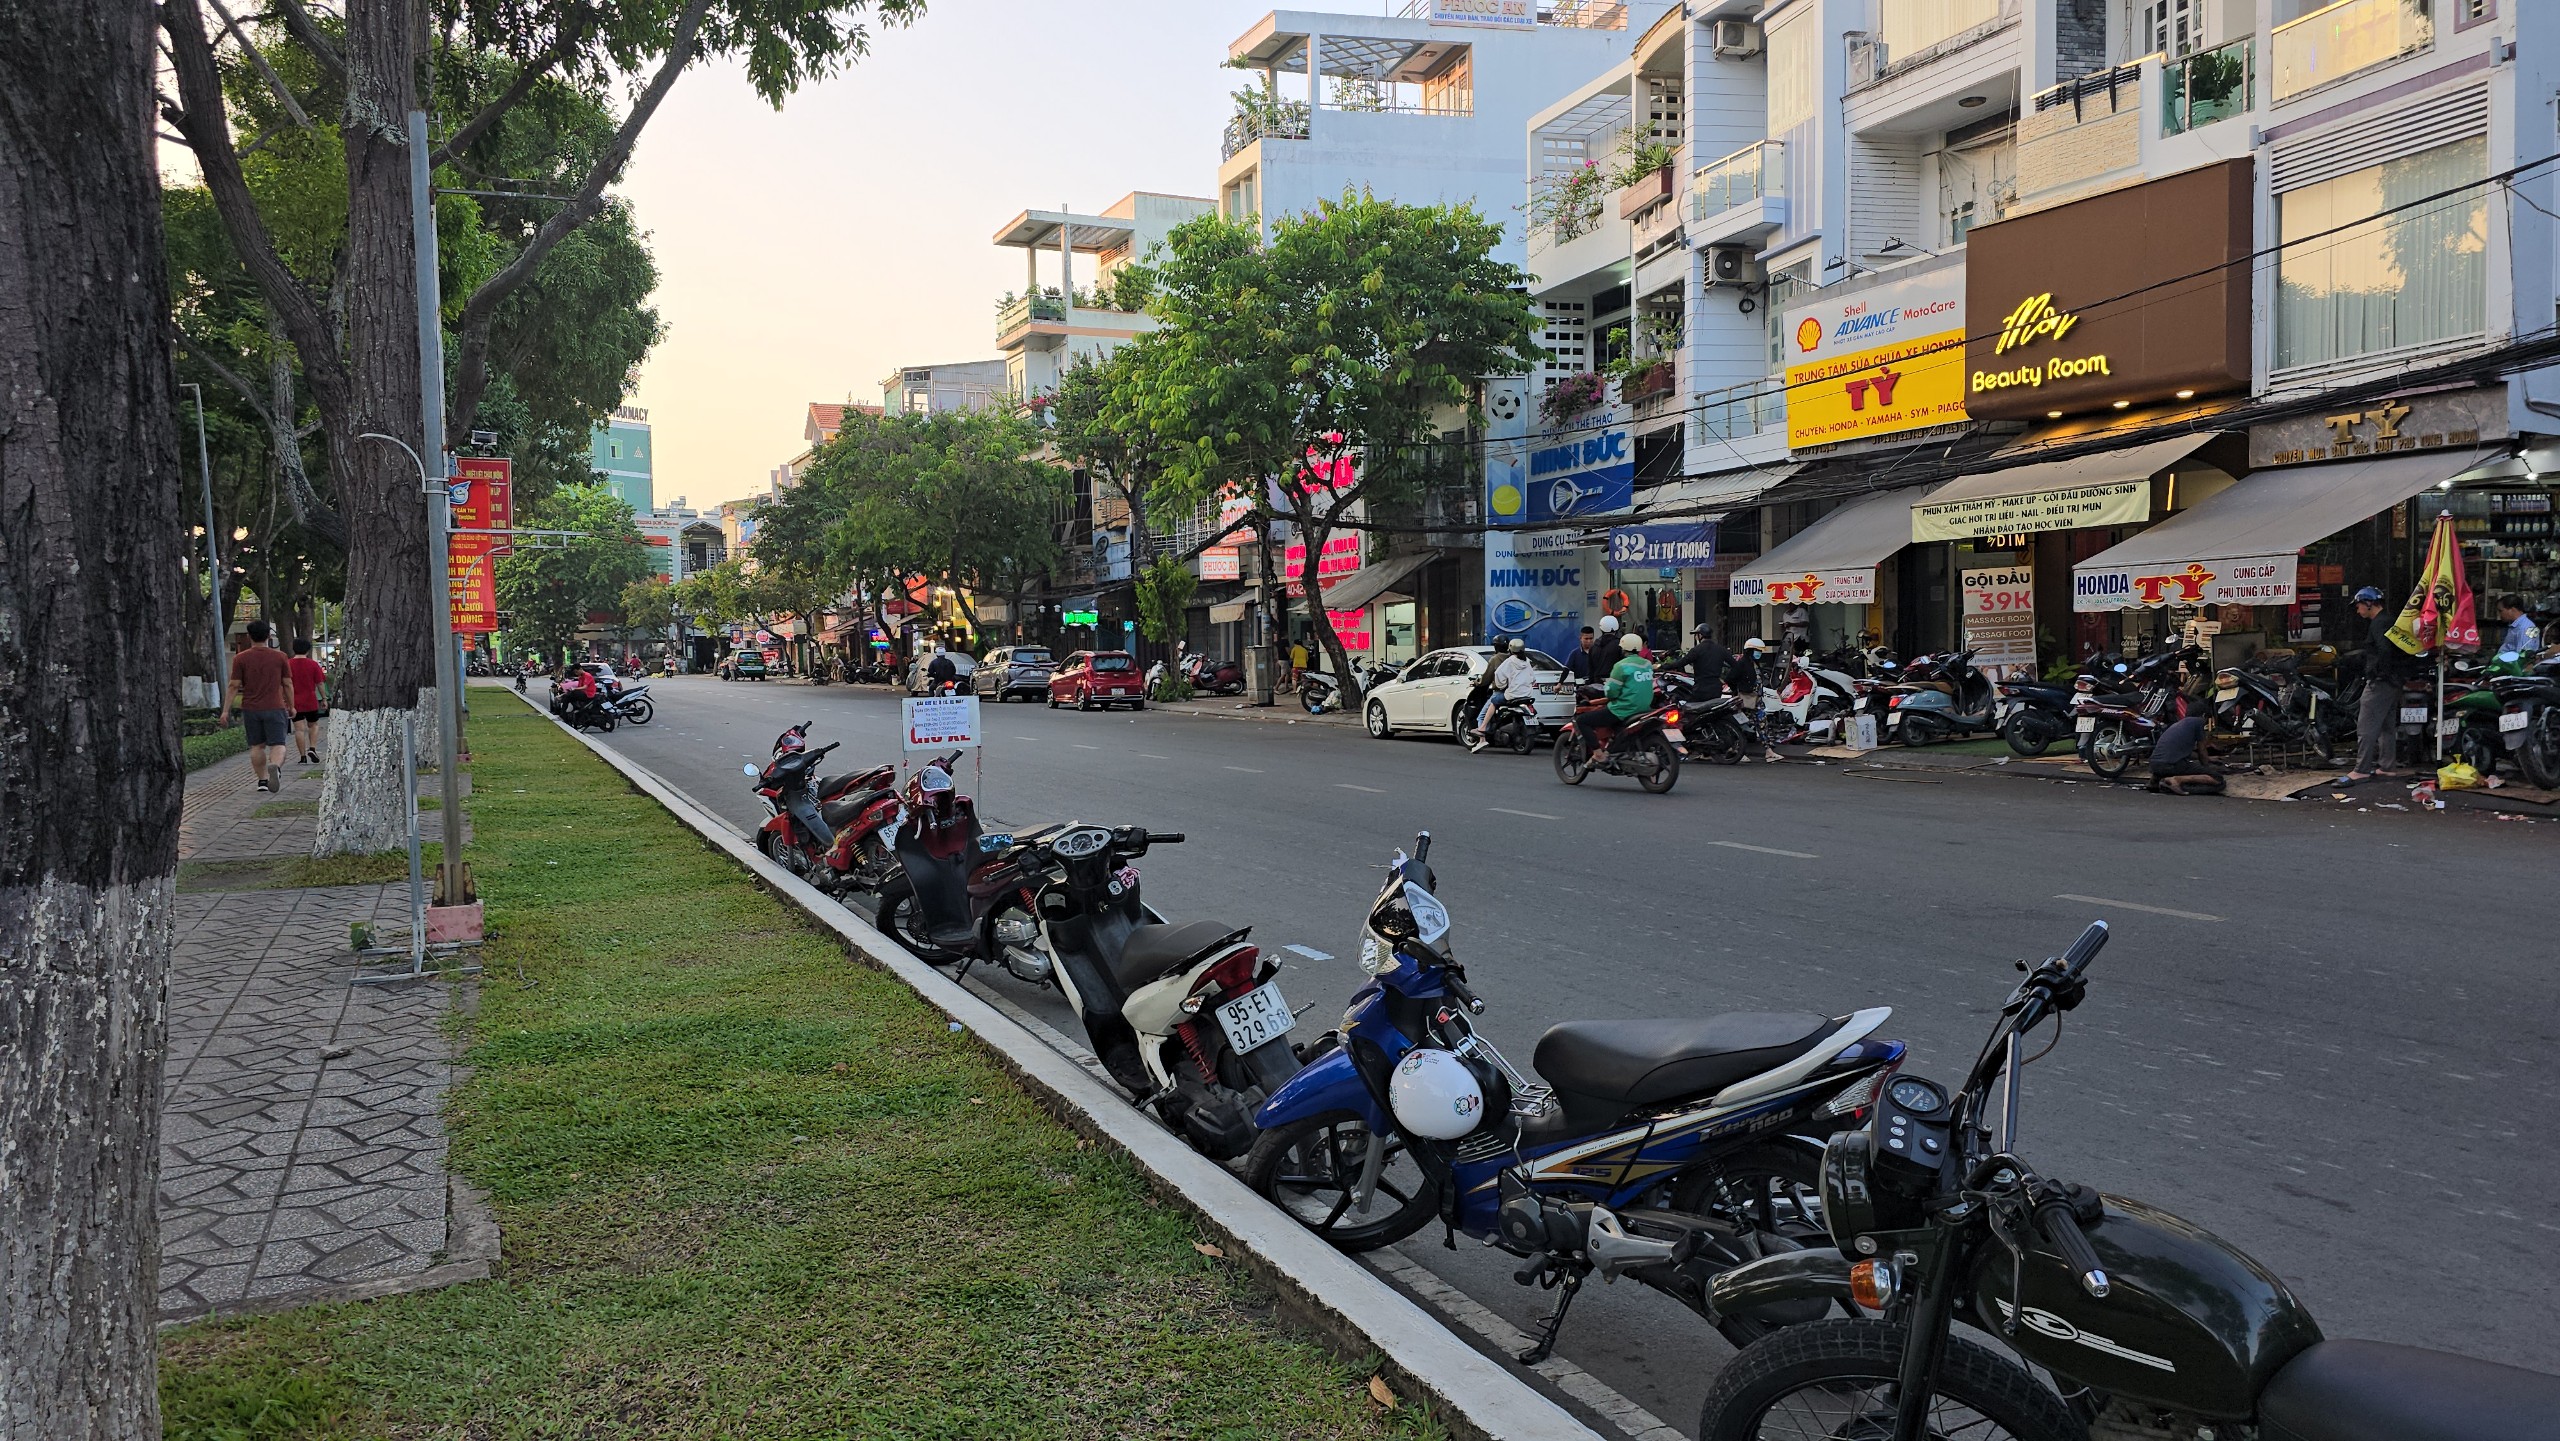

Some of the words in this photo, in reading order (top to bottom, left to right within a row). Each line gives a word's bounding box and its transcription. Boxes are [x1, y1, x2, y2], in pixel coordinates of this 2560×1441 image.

[1502, 1, 1526, 15] AN
[1844, 302, 1866, 318] Shell
[1904, 301, 1955, 320] MotoCare
[1834, 308, 1900, 338] ADVANCE
[1794, 369, 1825, 383] TRUNG
[1906, 346, 1918, 357] XE
[1922, 338, 1964, 354] HONDA
[1973, 366, 2042, 392] Beauty
[2048, 354, 2111, 380] Room
[609, 405, 648, 421] ARMACY
[1592, 413, 1613, 428] THAO
[1829, 420, 1858, 432] HONDA
[1866, 412, 1902, 426] YAMAHA
[1910, 407, 1928, 418] SYM
[1531, 443, 1580, 476] MINH
[1583, 429, 1625, 465] ĐỨC
[1923, 506, 1942, 516] PHUN
[2002, 497, 2024, 507] MAKE
[2026, 496, 2036, 505] UP
[2115, 484, 2136, 495] SINH
[2022, 509, 2039, 518] NAIL
[2066, 503, 2079, 514] TRỊ
[2082, 502, 2101, 513] MỤN
[2016, 522, 2033, 532] TẠO
[2035, 520, 2052, 530] HỌC
[1532, 536, 1553, 550] DỤNG
[1555, 536, 1564, 550] CỤ
[1615, 534, 1646, 561] 32
[1648, 540, 1660, 559] LÝ
[1662, 541, 1676, 563] TỰ
[1677, 541, 1710, 562] TRỌNG
[1997, 534, 2025, 547] DIM
[456, 555, 484, 564] DOANH
[1229, 562, 1237, 571] AN
[1490, 569, 1538, 587] MINH
[1542, 565, 1580, 586] ĐỨC
[1965, 573, 1993, 589] GỘI
[1996, 568, 2030, 585] ĐẦU
[2234, 566, 2255, 579] CUNG
[2258, 562, 2276, 577] CẤP
[1734, 579, 1763, 595] HONDA
[1834, 577, 1850, 585] TRUNG
[2077, 574, 2129, 595] HONDA
[466, 591, 479, 599] TIN
[2218, 587, 2234, 600] PHỤ
[2236, 583, 2257, 598] TÙNG
[2260, 585, 2271, 597] XE
[2274, 582, 2291, 596] MÁY
[1980, 591, 2031, 611] 39K
[461, 613, 483, 623] DÙNG
[1228, 990, 1272, 1024] 95-E1
[1233, 1008, 1289, 1049] 329.68
[1572, 1167, 1612, 1177] 125
